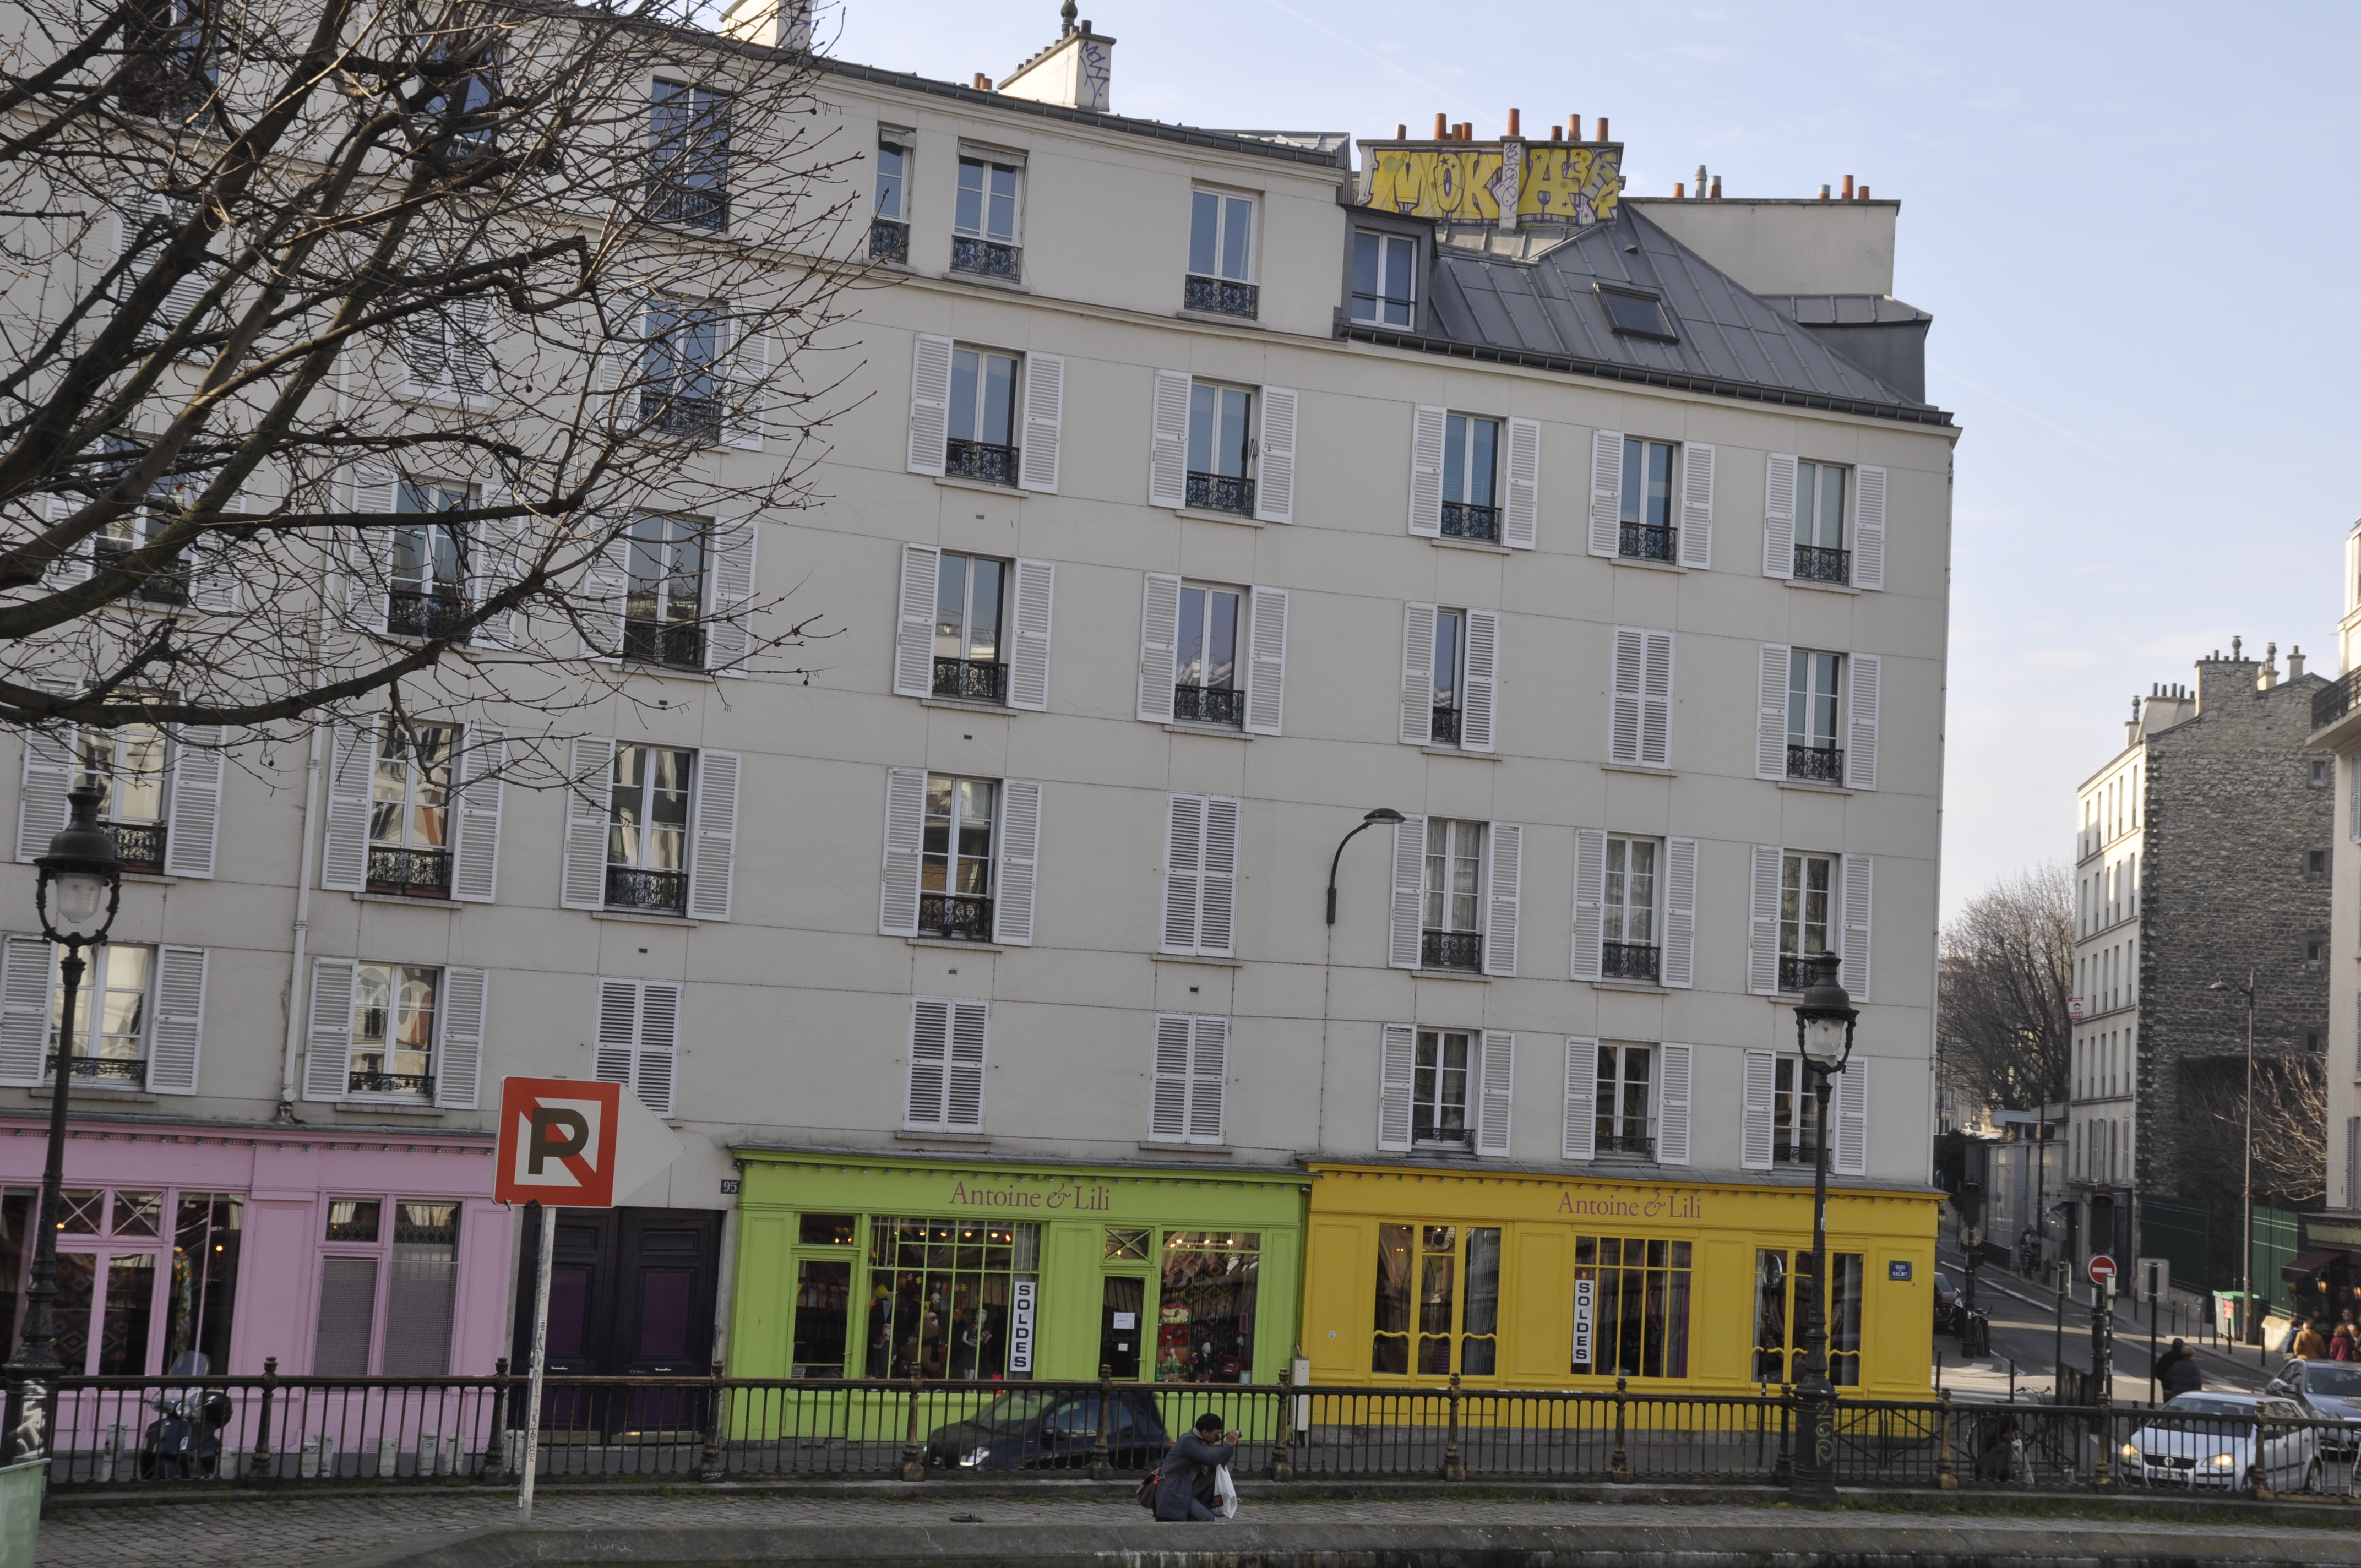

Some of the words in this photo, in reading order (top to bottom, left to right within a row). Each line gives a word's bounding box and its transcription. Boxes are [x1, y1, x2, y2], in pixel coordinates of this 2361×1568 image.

[723, 1180, 737, 1193] 95
[949, 1180, 1041, 1207] Antoine
[1047, 1183, 1071, 1209] &
[1073, 1186, 1110, 1211] Lili
[1557, 1191, 1639, 1216] Antoine
[1644, 1192, 1666, 1217] &
[1668, 1196, 1701, 1218] Lili
[1014, 1284, 1031, 1368] SOLDES
[1576, 1282, 1590, 1360] SOLDES
